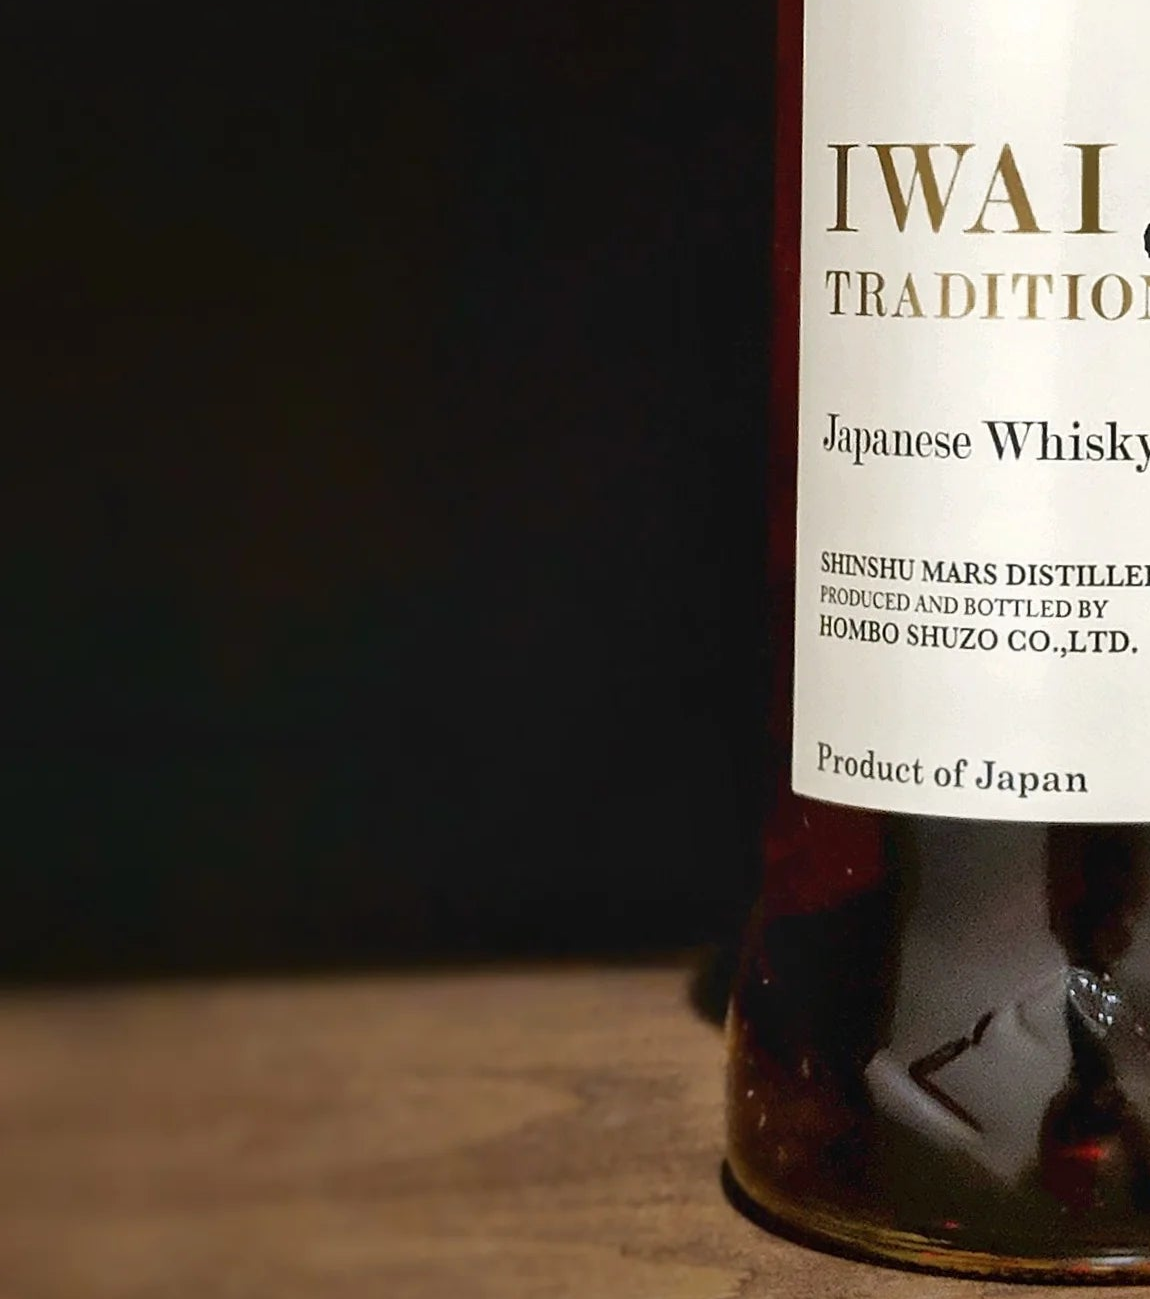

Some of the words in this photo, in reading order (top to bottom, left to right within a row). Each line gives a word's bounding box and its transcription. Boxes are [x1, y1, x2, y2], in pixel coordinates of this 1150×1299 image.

[826, 143, 1117, 234] IWAI
[823, 413, 973, 465] Japanese
[821, 551, 915, 581] SHINSHU
[922, 560, 997, 586] MARS
[820, 584, 911, 612] PRODUCED
[914, 596, 959, 615] AND
[964, 599, 1073, 619] BOTTLED
[1077, 599, 1109, 619] BY
[819, 614, 900, 645] HOMBO
[906, 624, 999, 651] SHUZO
[1007, 629, 1139, 658] CO.,LTD.
[816, 742, 924, 786] Product
[933, 759, 968, 789] of
[975, 760, 1089, 800] Japan
